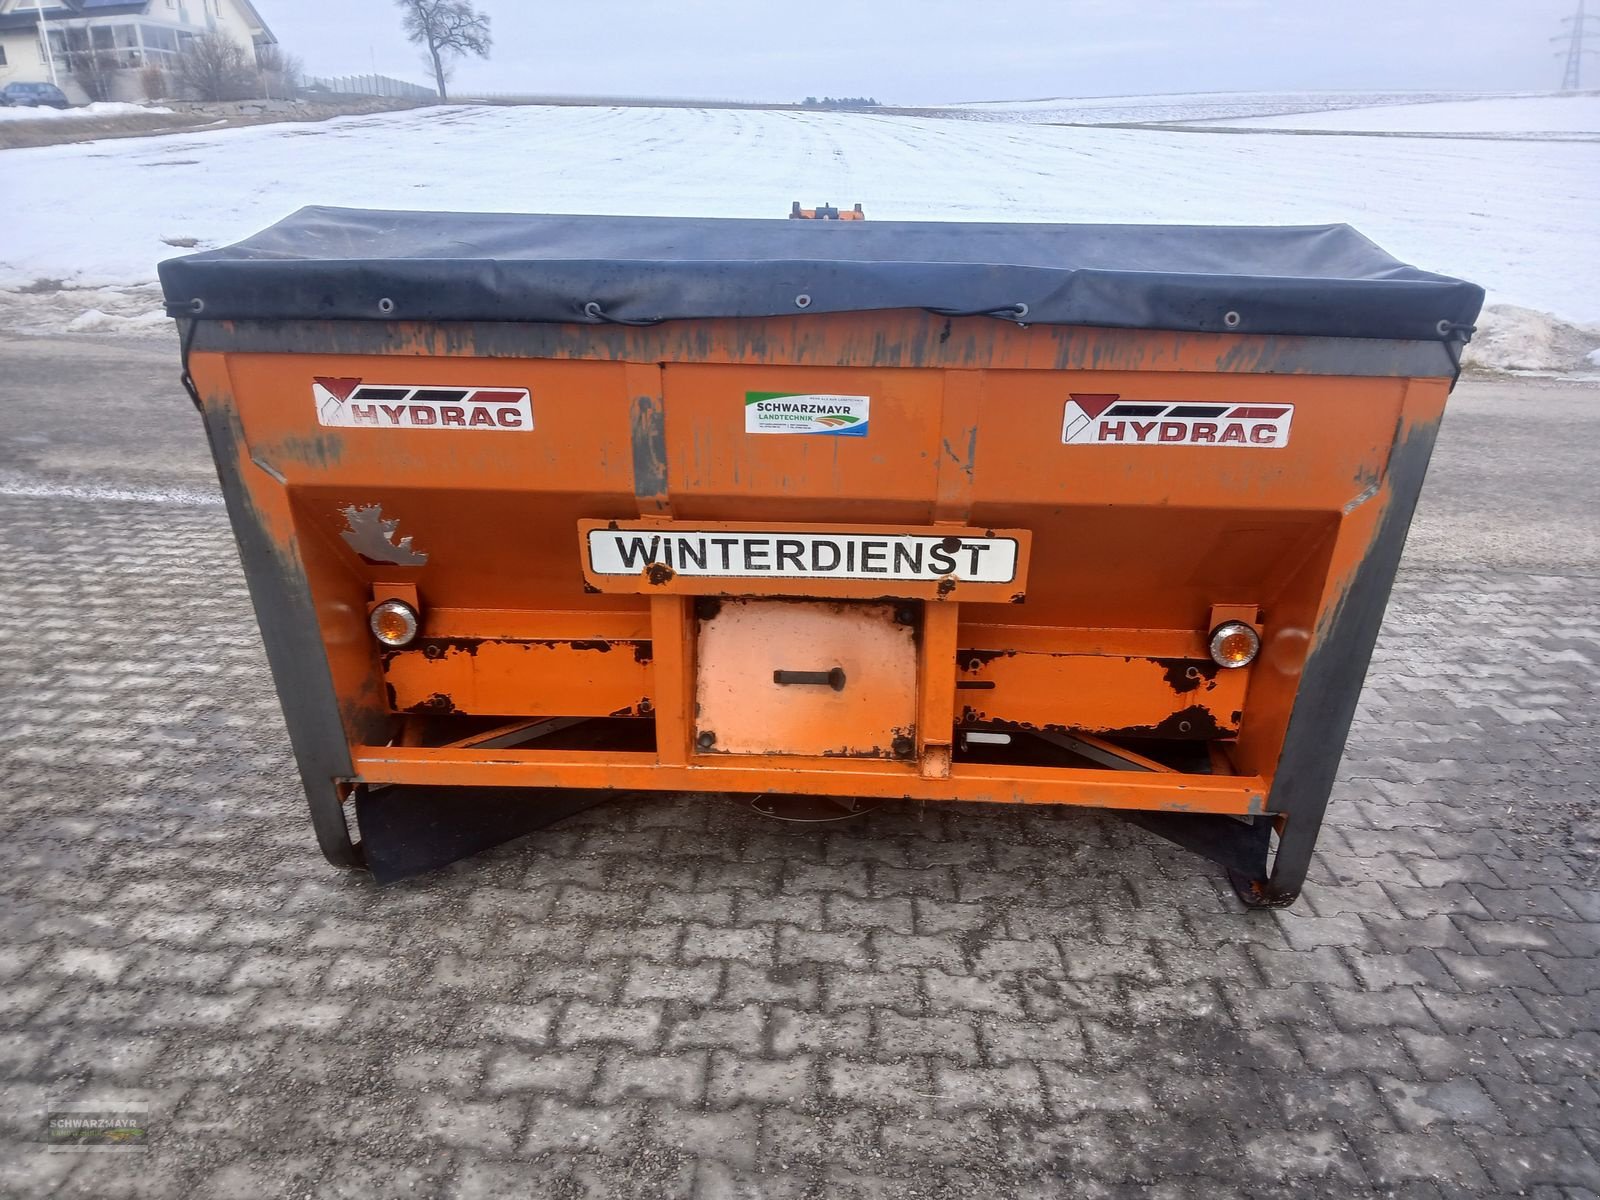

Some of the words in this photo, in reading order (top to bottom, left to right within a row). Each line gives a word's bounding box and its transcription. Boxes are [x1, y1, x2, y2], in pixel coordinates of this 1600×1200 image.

[350, 404, 523, 428] HYDRAC
[756, 402, 851, 415] SCHWARZMAYR
[758, 413, 814, 422] LANDTECHNIK
[1098, 421, 1278, 444] HYDRAC
[613, 535, 991, 576] WINTERDIENST
